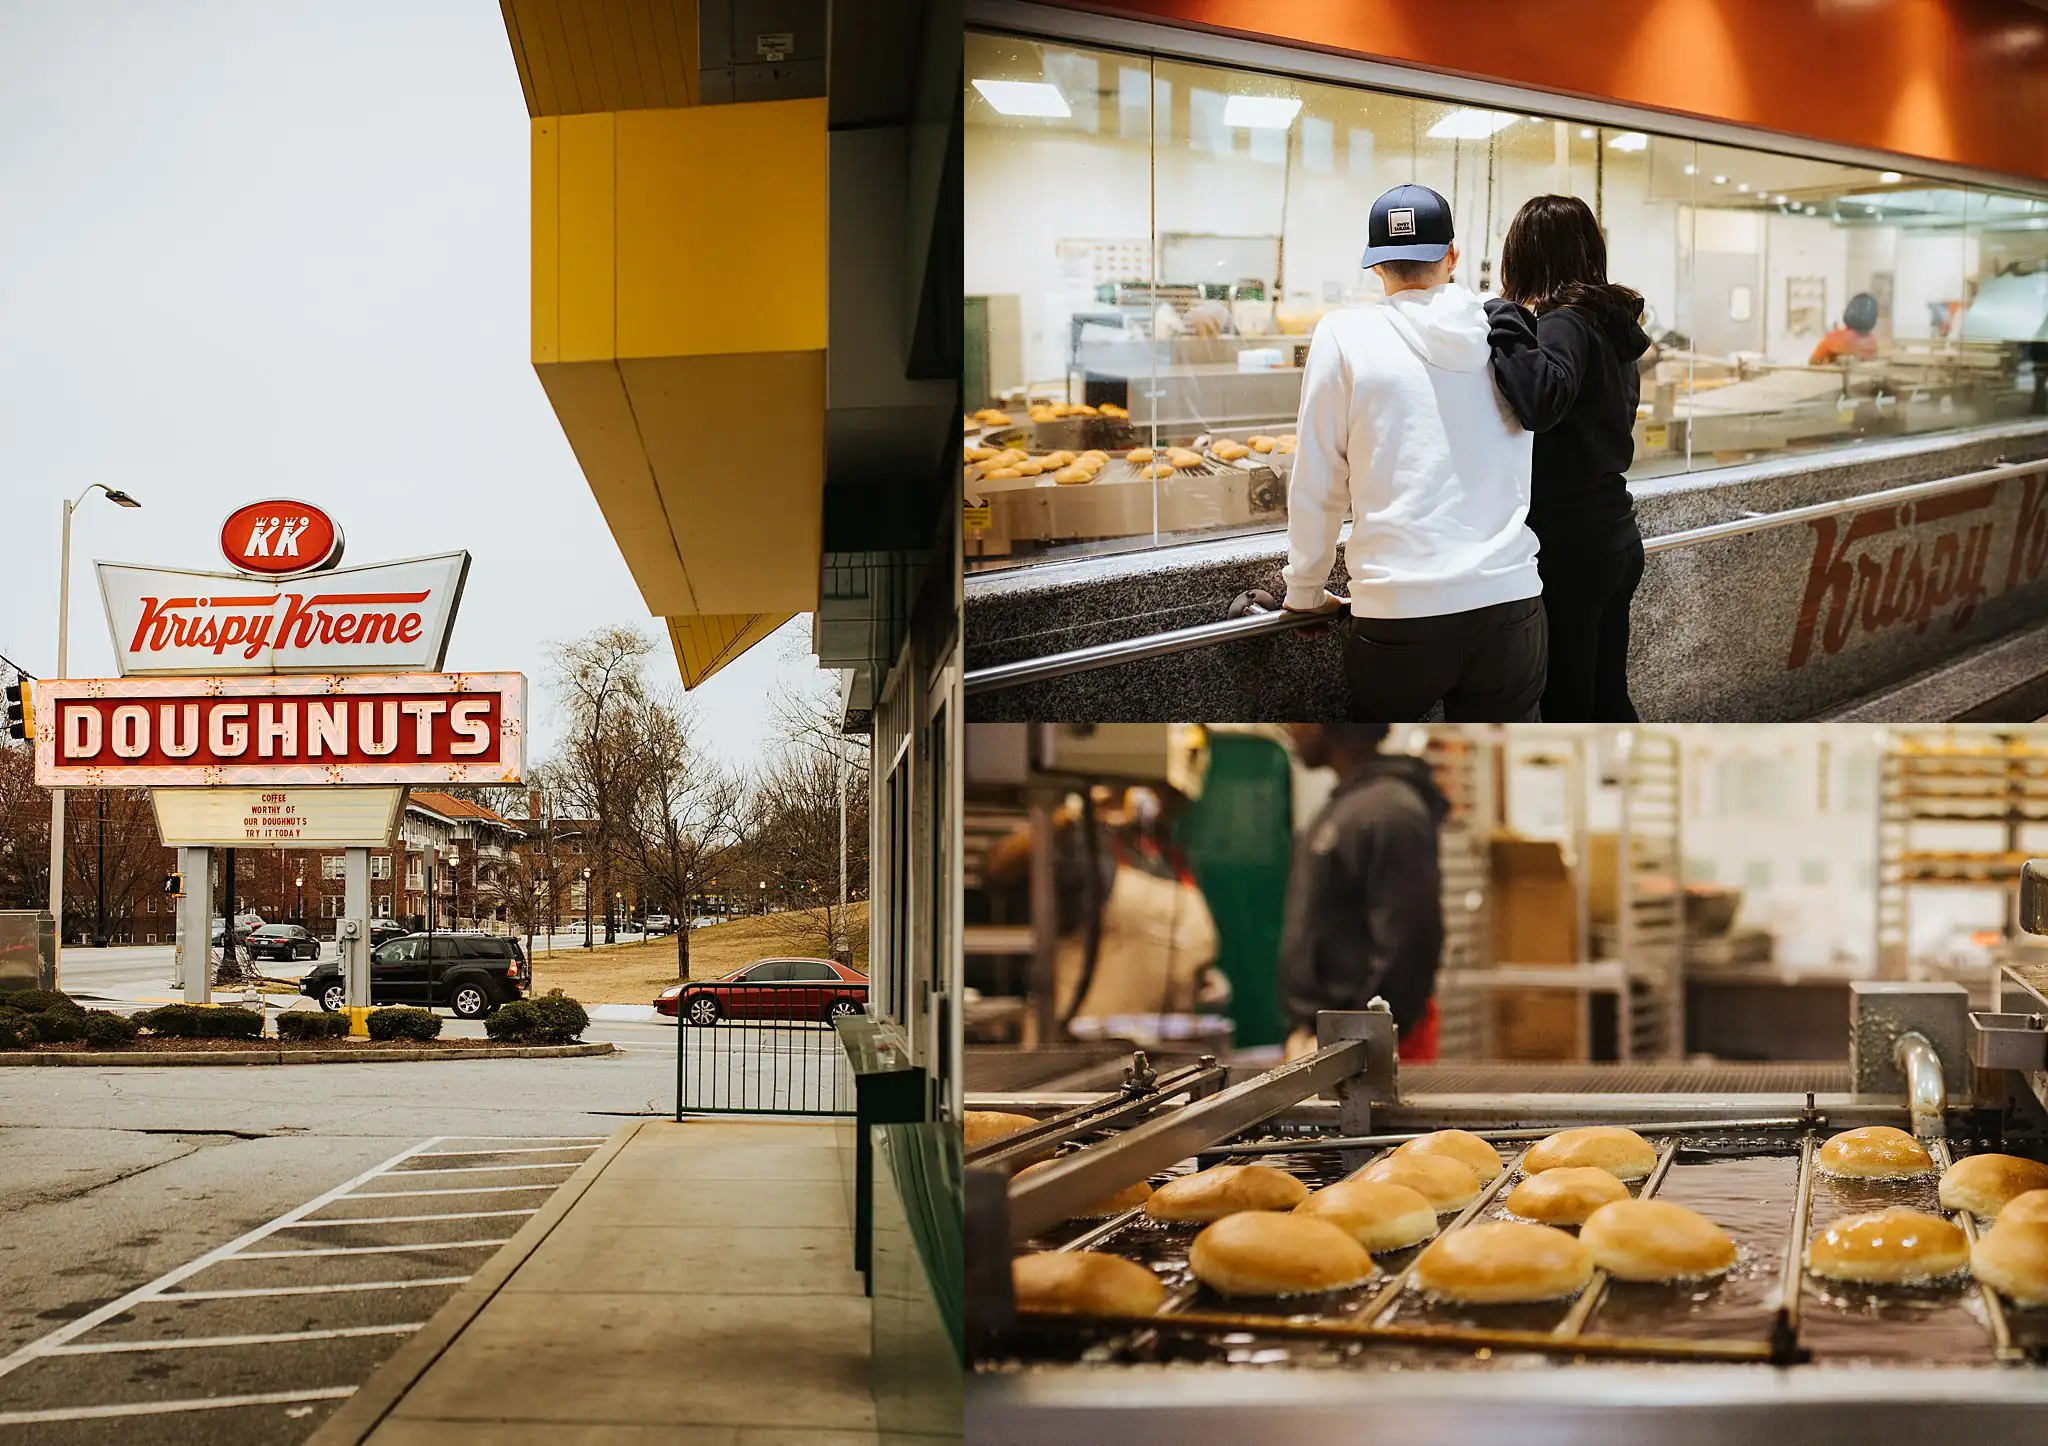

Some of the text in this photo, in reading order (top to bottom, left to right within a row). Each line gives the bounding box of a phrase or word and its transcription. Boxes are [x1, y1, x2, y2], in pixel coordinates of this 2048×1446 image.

[243, 516, 310, 557] KK
[1786, 480, 1999, 671] Krispy
[129, 589, 431, 660] Krispy Kreme
[64, 700, 491, 758] DOUGHNUTS
[251, 805, 296, 814] WORTHY OF
[261, 794, 286, 802] COFFEE
[243, 817, 307, 826] OUR DOUGHNUTS
[246, 829, 300, 837] TRY IT TODAY
